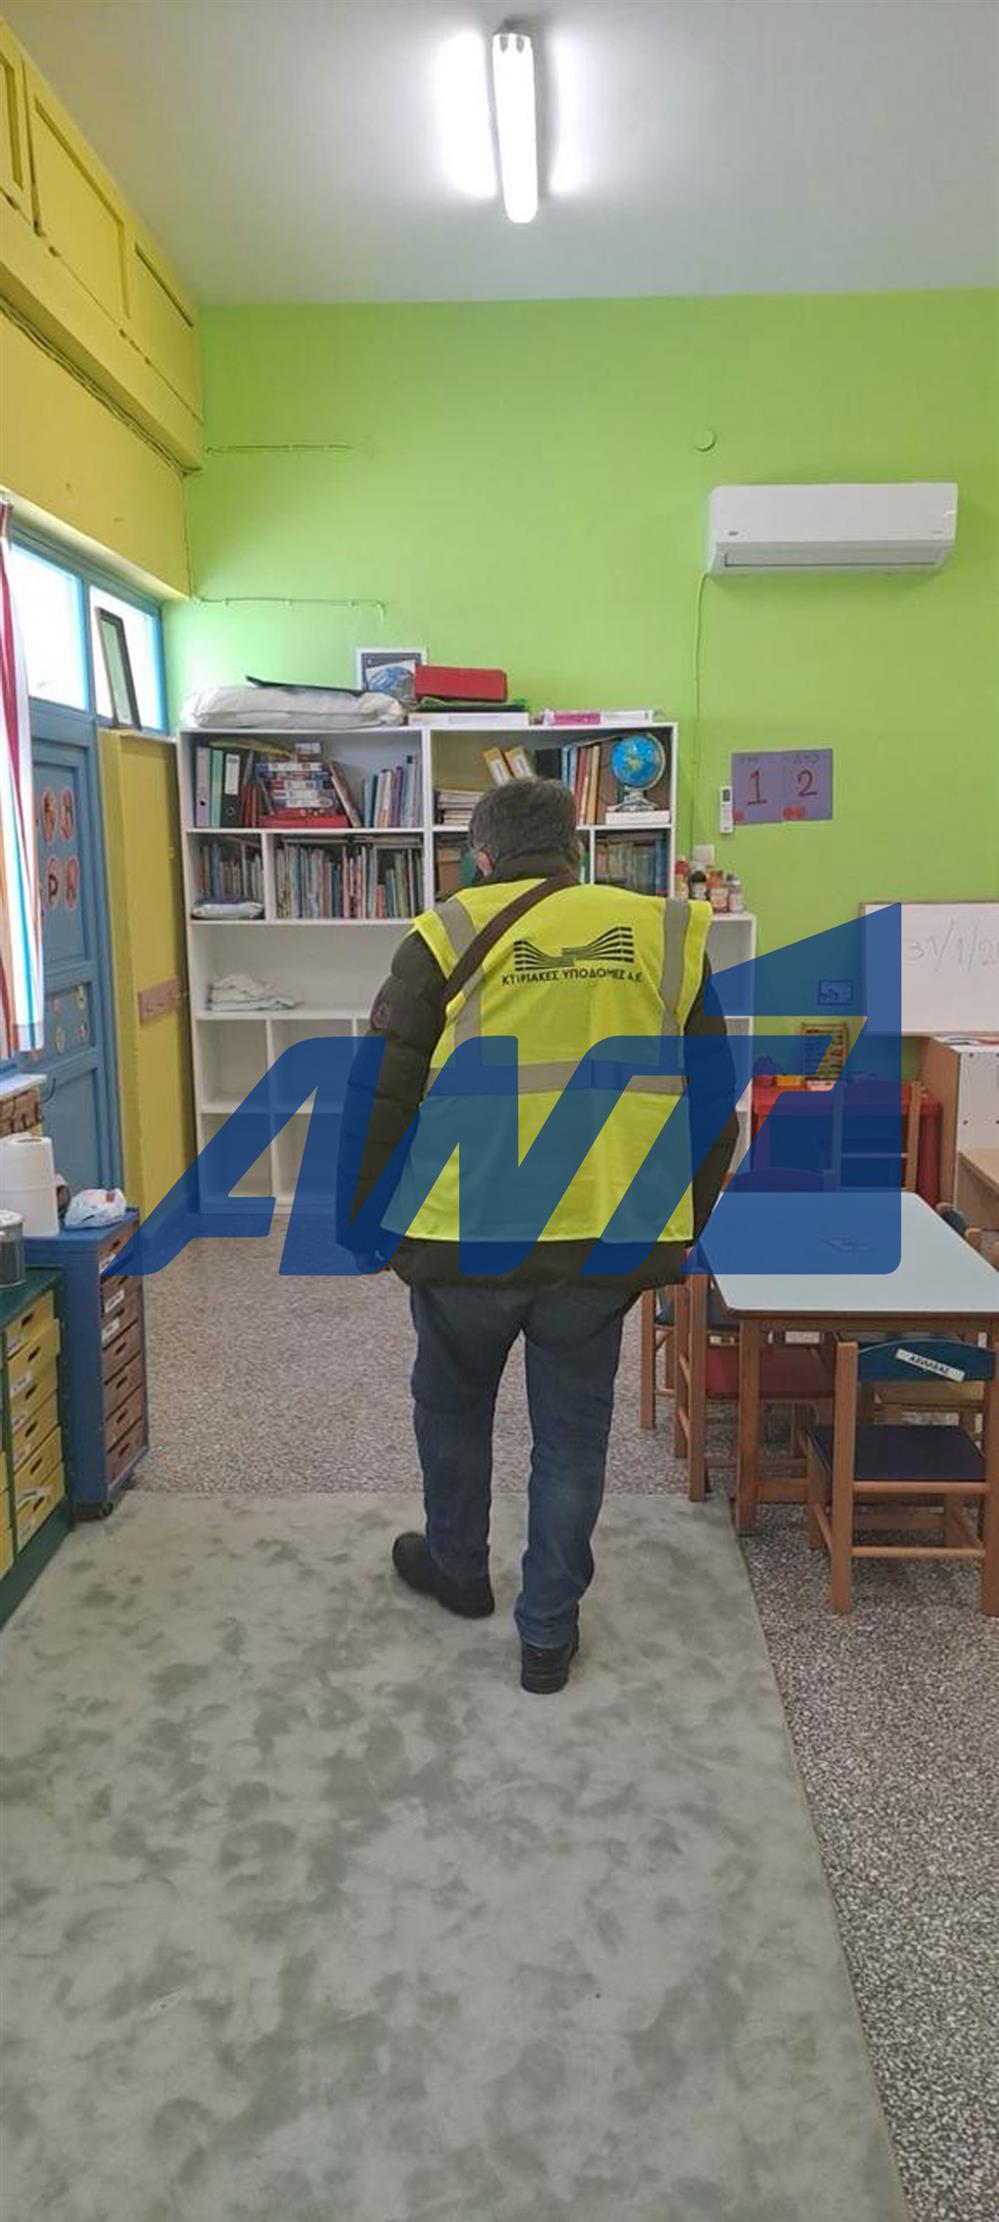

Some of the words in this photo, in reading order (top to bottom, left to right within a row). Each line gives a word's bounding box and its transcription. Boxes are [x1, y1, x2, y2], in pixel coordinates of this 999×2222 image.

[747, 769, 767, 805] 1
[797, 769, 818, 797] 2
[907, 918, 999, 973] 31/1/2
[502, 971, 559, 985] ΚΤΙΡΙΑΚΕΣ
[561, 968, 625, 980] ΥΠΟΔΟΜΕΣ
